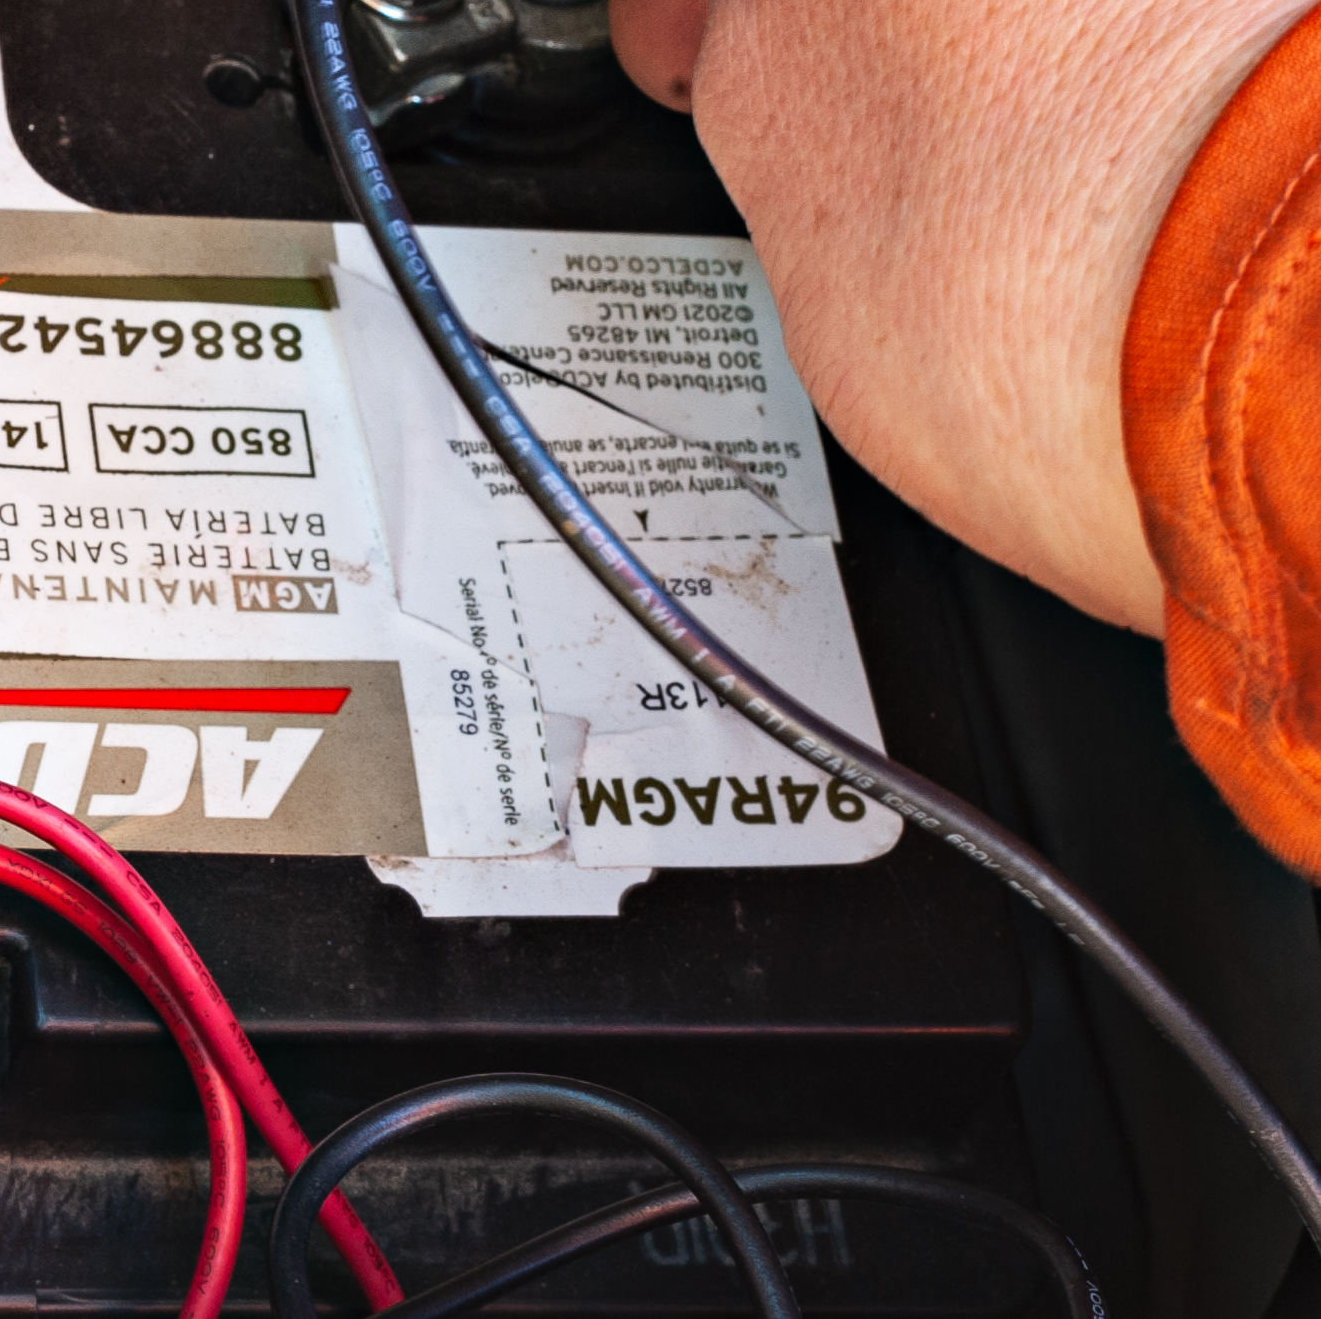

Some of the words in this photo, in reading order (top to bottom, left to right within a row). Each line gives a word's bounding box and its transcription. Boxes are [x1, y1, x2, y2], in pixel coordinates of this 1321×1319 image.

[566, 254, 744, 277] ACDELCO.COM
[551, 277, 646, 298] Reserved
[652, 278, 717, 299] Rights
[722, 283, 747, 299] All
[596, 303, 637, 320] LLC
[643, 304, 677, 322] GM
[567, 324, 639, 343] 48265
[645, 328, 670, 344] MI
[676, 326, 758, 345] Detroit,
[579, 348, 711, 368] Renaissance
[718, 351, 762, 369] 300
[616, 369, 640, 390] by
[646, 372, 766, 393] Distributed
[107, 423, 194, 455] CCA
[212, 427, 292, 457] 850
[656, 456, 697, 474] nulle
[649, 480, 684, 497] void
[38, 504, 146, 530] LIBRE
[165, 509, 326, 539] BATERÍA
[30, 538, 128, 566] SANS
[148, 542, 331, 572] BATTERIE
[238, 579, 334, 611] AGM
[451, 669, 478, 736] 85279
[481, 669, 499, 689] de
[496, 764, 515, 783] de
[577, 776, 866, 826] 94RAGM
